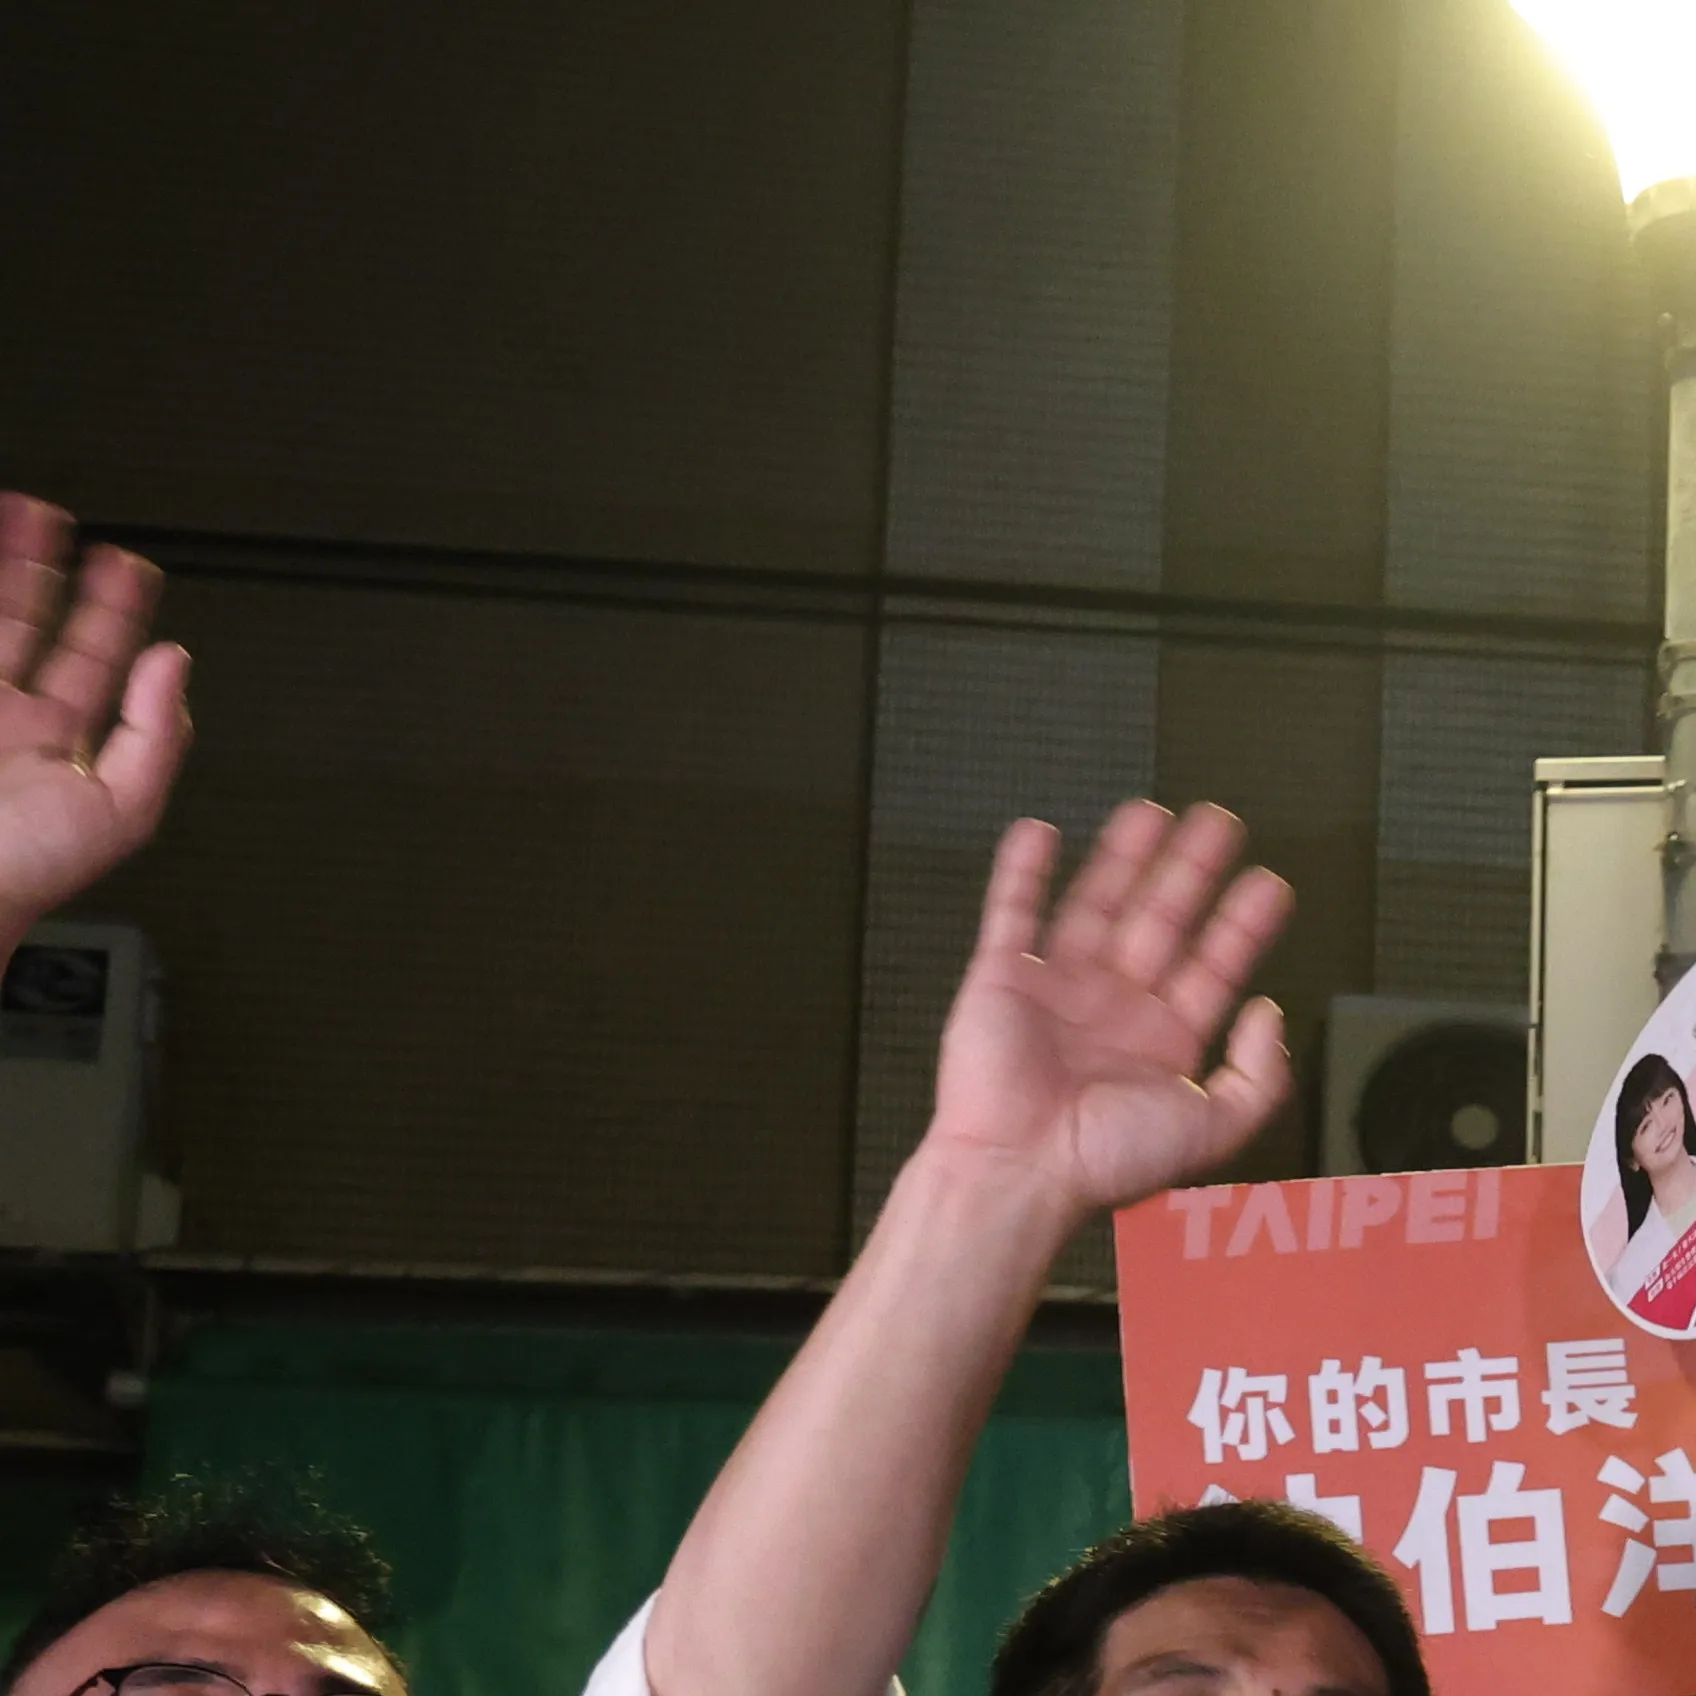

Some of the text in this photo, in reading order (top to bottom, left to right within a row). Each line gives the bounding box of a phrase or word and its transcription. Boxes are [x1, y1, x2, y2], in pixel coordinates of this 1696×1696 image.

[1168, 1171, 1503, 1260] TAIPEI
[1187, 1337, 1638, 1463] 你的市長
